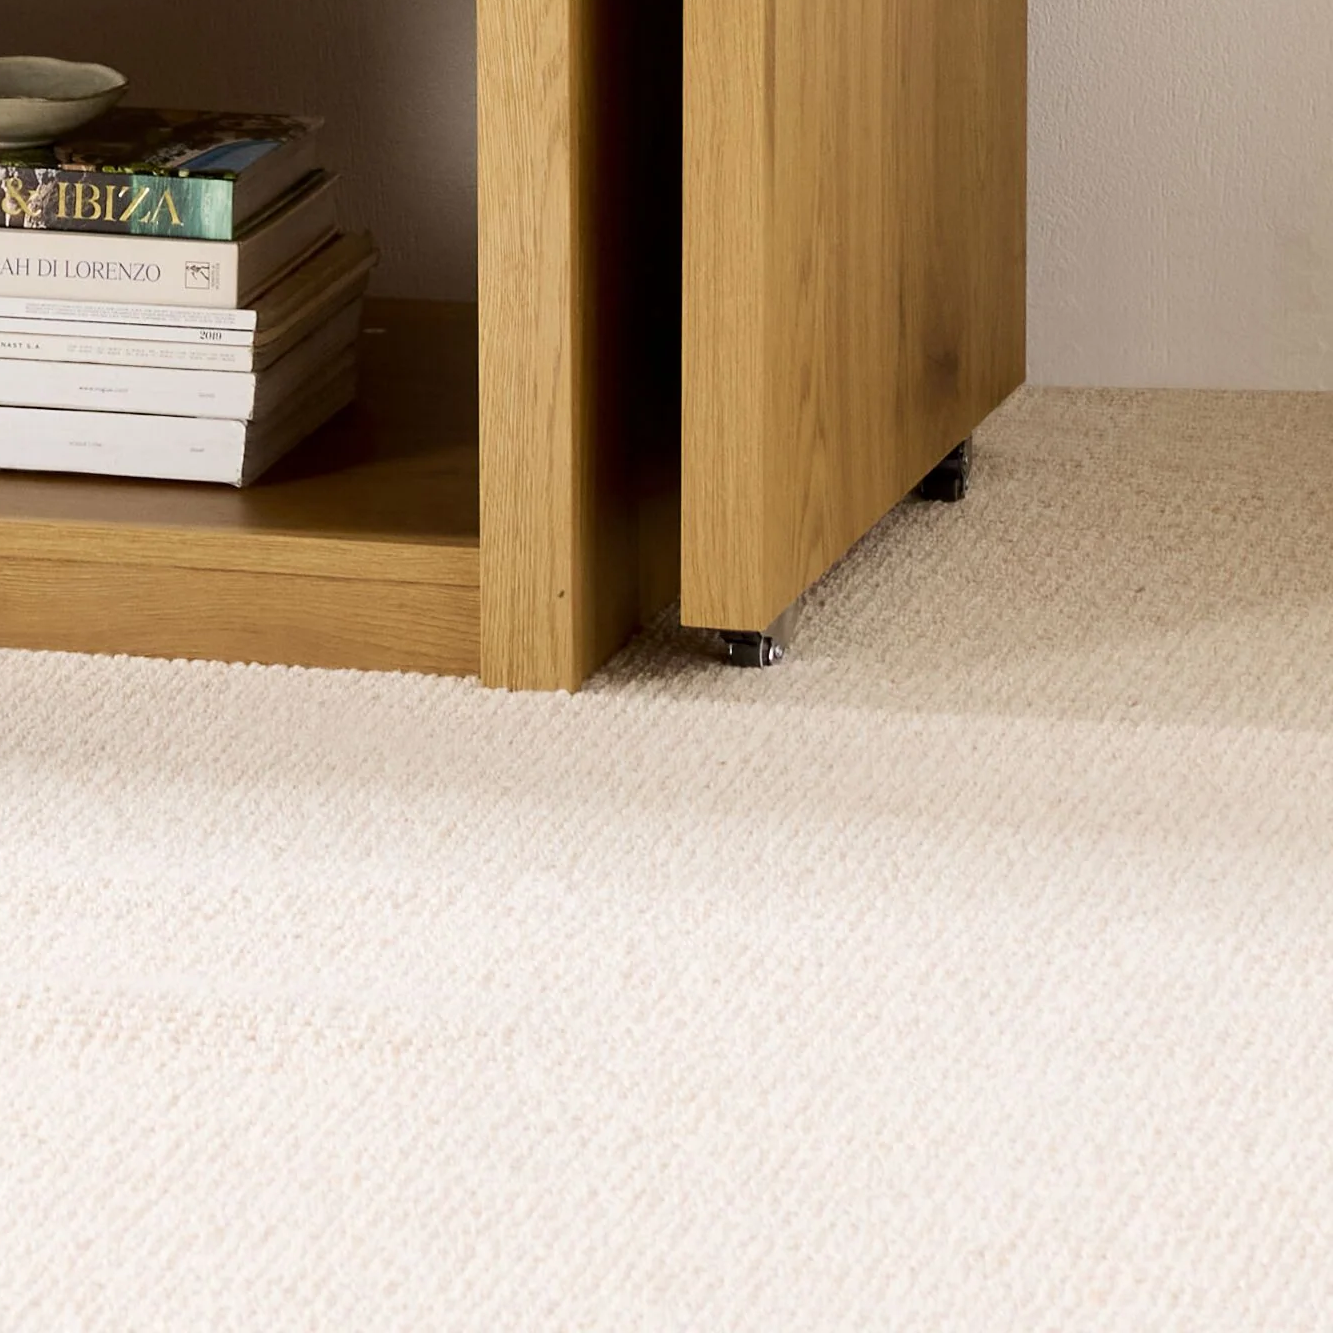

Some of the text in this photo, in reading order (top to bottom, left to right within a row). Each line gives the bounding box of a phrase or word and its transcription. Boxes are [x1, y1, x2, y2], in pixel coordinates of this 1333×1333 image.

[1, 175, 41, 215] &
[56, 182, 183, 226] IBIZA
[38, 259, 57, 278] DI
[65, 260, 161, 283] LORENZO
